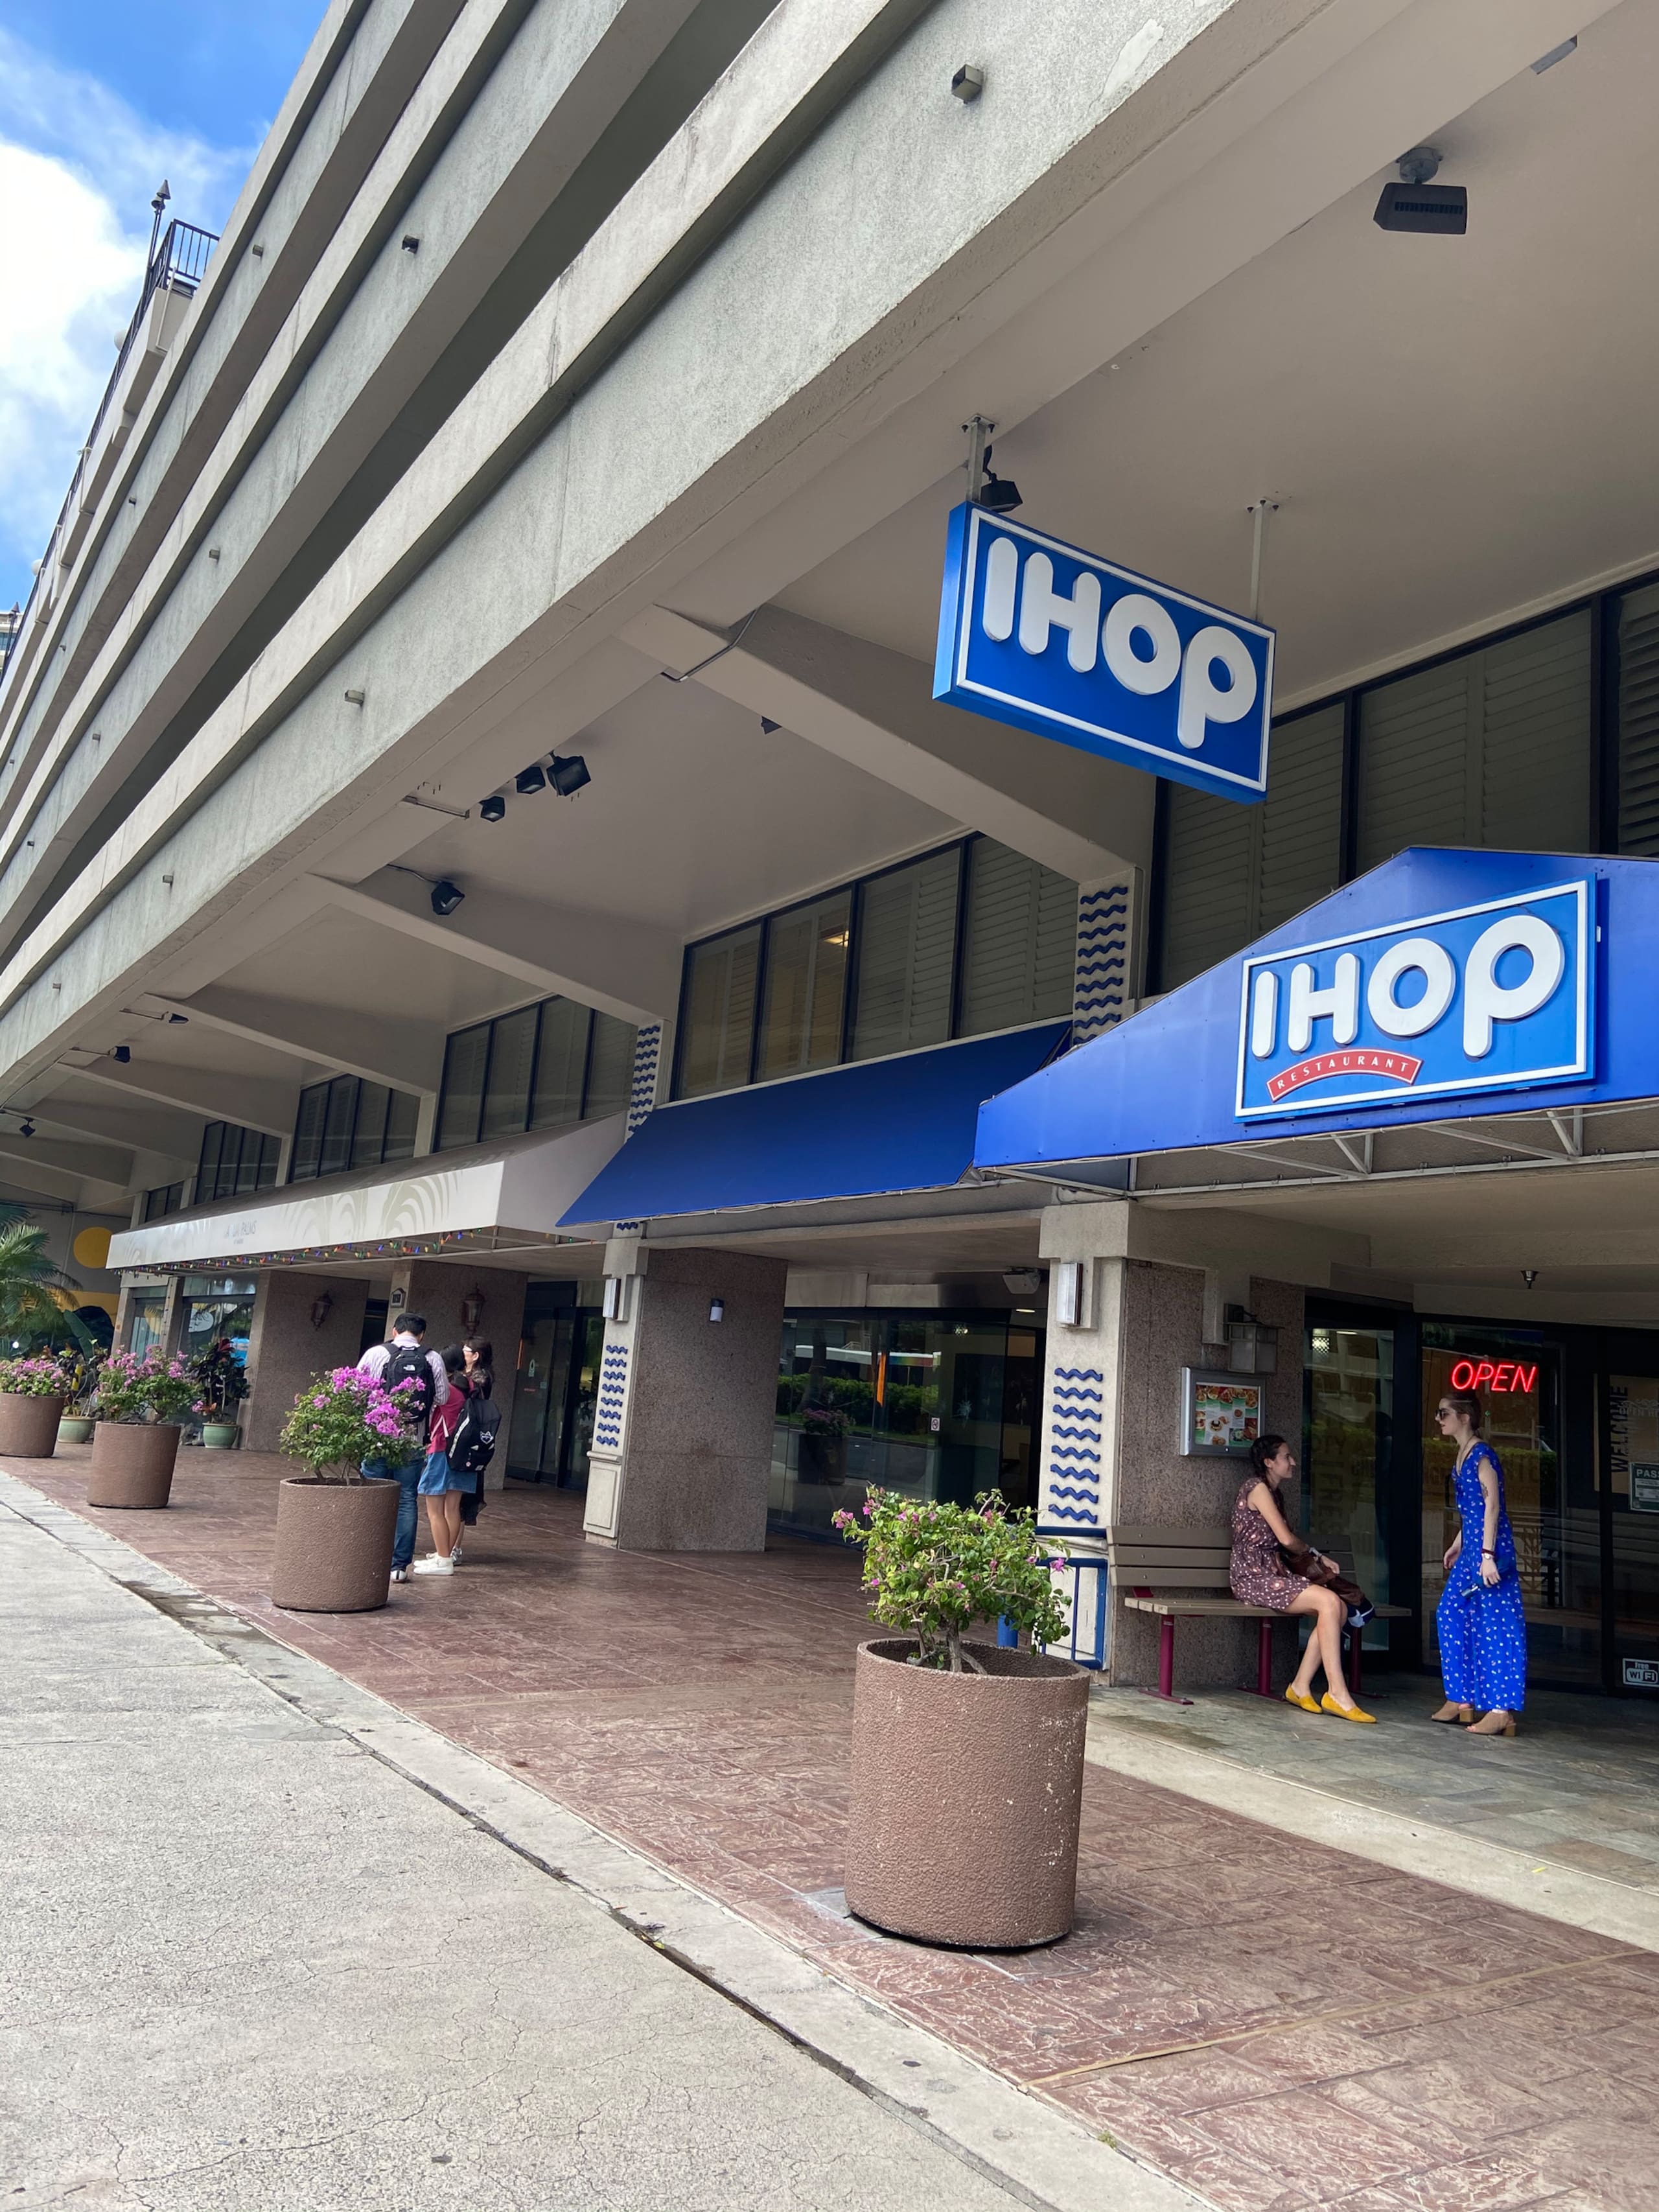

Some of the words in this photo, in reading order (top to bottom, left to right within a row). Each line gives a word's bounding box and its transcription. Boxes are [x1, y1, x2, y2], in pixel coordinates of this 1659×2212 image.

[982, 537, 1257, 749] IHOP
[1251, 914, 1565, 1058] IHOP
[1277, 1054, 1410, 1089] RESTAURANT
[1451, 1361, 1537, 1393] OPEN
[1608, 1386, 1628, 1472] WELCOME
